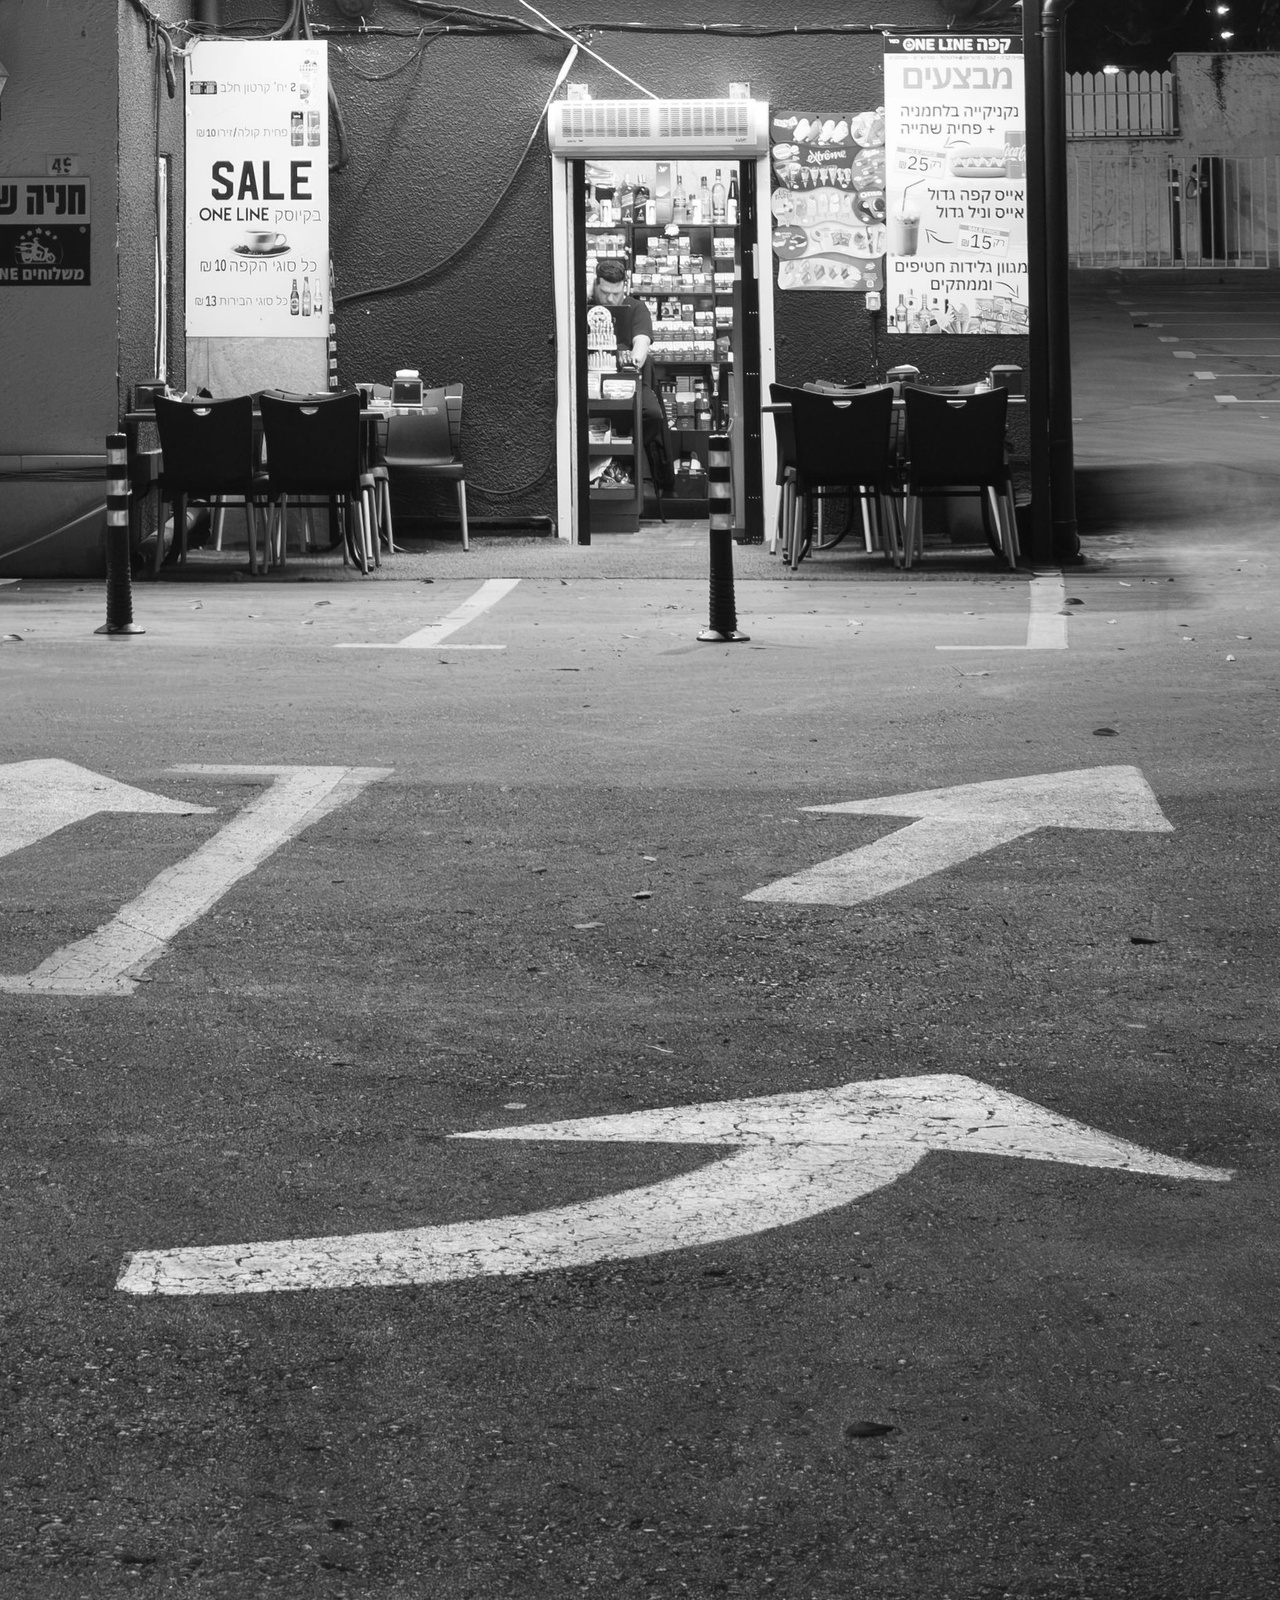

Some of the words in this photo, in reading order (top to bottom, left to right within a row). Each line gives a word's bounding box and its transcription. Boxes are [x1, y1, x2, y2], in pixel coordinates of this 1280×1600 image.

[903, 37, 935, 52] ONE
[939, 38, 973, 51] LINE
[977, 38, 1011, 54] קפה
[903, 67, 1012, 90] מבצעים
[220, 82, 241, 93] חלב
[244, 83, 271, 95] קרטון
[901, 104, 959, 117] בלחמניה
[964, 106, 1019, 120] נקניקייה
[263, 128, 288, 138] פחית
[901, 123, 942, 135] שתייה
[947, 123, 982, 135] פחית
[908, 156, 929, 171] 25
[211, 160, 313, 200] SALE
[27, 185, 86, 215] חניה
[928, 188, 955, 201] גדול
[960, 190, 991, 204] קפה
[995, 190, 1024, 201] אייס
[199, 207, 232, 221] ONE
[237, 207, 269, 221] LINE
[275, 210, 322, 224] בקיוסק
[936, 205, 964, 218] גדול
[968, 205, 991, 218] וניל
[995, 207, 1024, 218] אייס
[971, 234, 992, 250] 15
[229, 260, 268, 275] הקפה
[272, 260, 297, 272] סוגי
[301, 258, 317, 272] כל
[895, 262, 946, 273] חטיפים
[949, 260, 993, 273] גלידות
[997, 262, 1027, 276] מגוון
[22, 267, 85, 281] משלוחים
[931, 279, 992, 294] וממתקים
[219, 296, 253, 306] הבירות
[255, 297, 274, 306] סוגי
[276, 295, 288, 306] כל
